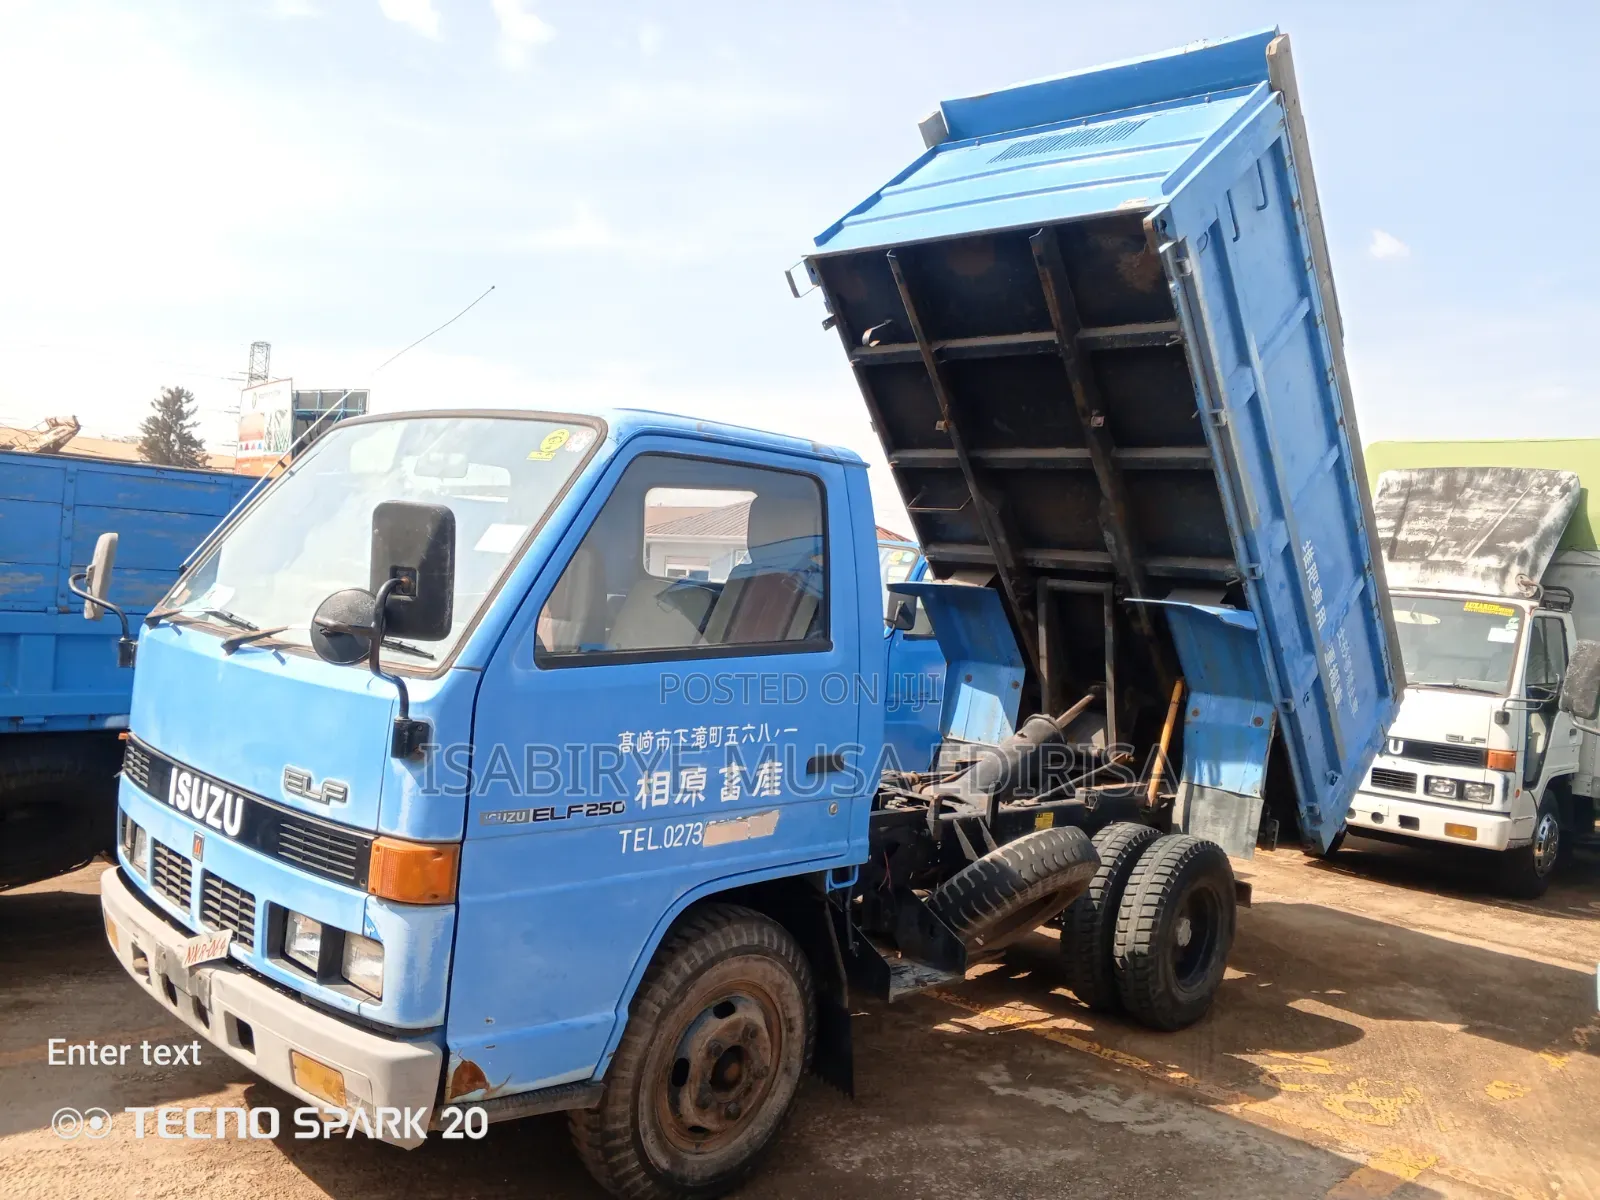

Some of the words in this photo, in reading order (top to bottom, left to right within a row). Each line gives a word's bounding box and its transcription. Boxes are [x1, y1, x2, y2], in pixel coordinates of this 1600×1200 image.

[168, 767, 244, 837] ISUZU
[284, 764, 348, 806] ELF
[485, 810, 526, 824] UZU
